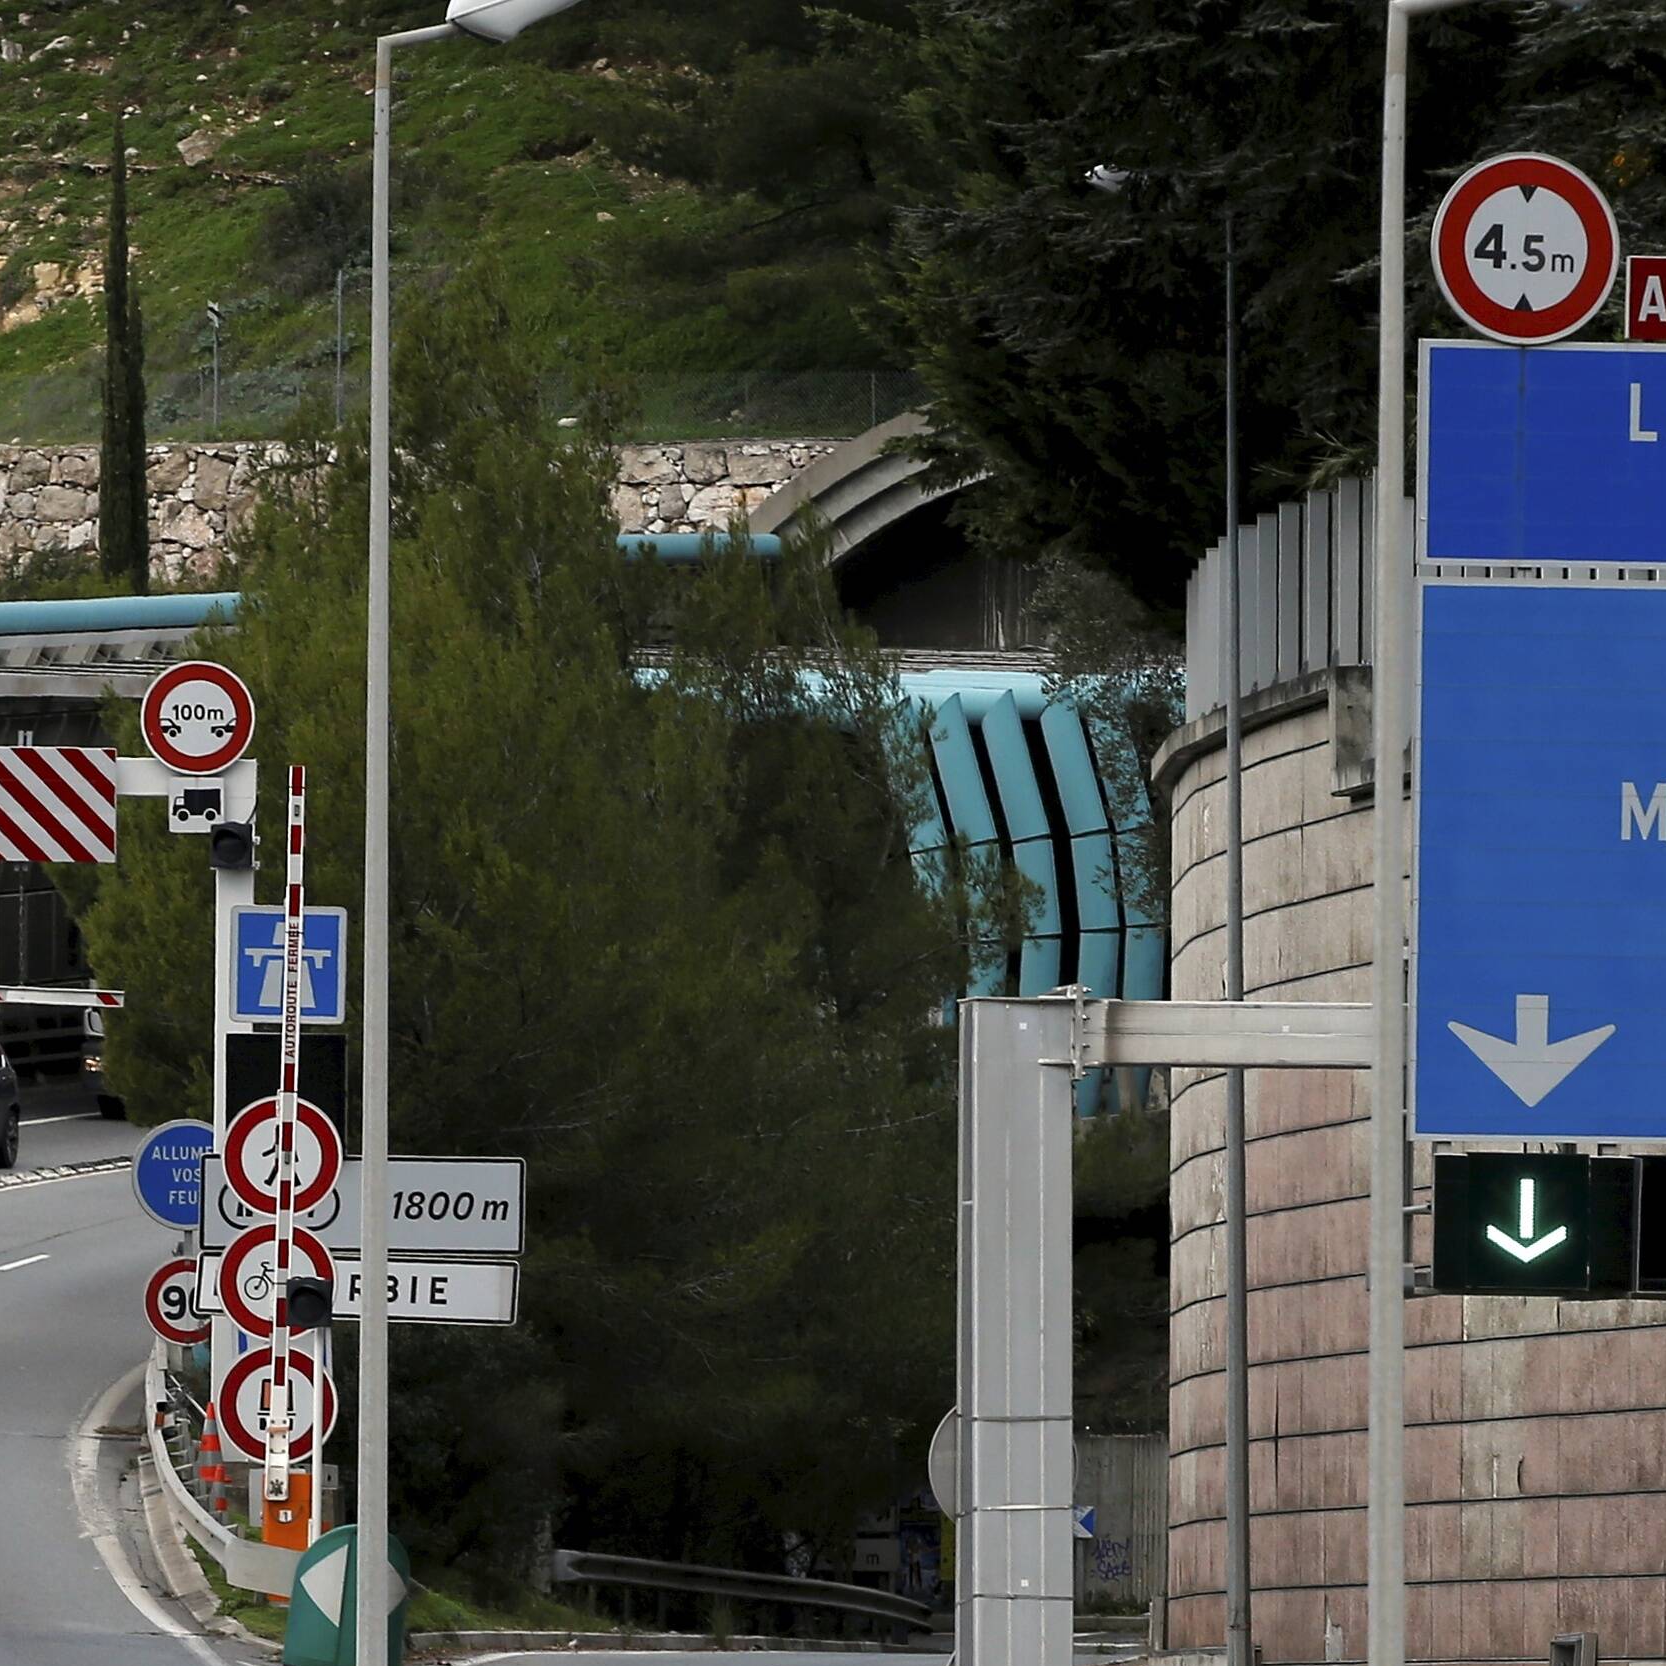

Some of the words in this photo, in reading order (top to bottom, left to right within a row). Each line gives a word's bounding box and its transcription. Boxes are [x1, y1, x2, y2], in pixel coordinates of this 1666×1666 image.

[1474, 223, 1574, 273] 4.5m
[172, 704, 224, 720] 100m
[284, 980, 298, 1058] AUTOROUTE
[172, 1168, 201, 1183] VOS
